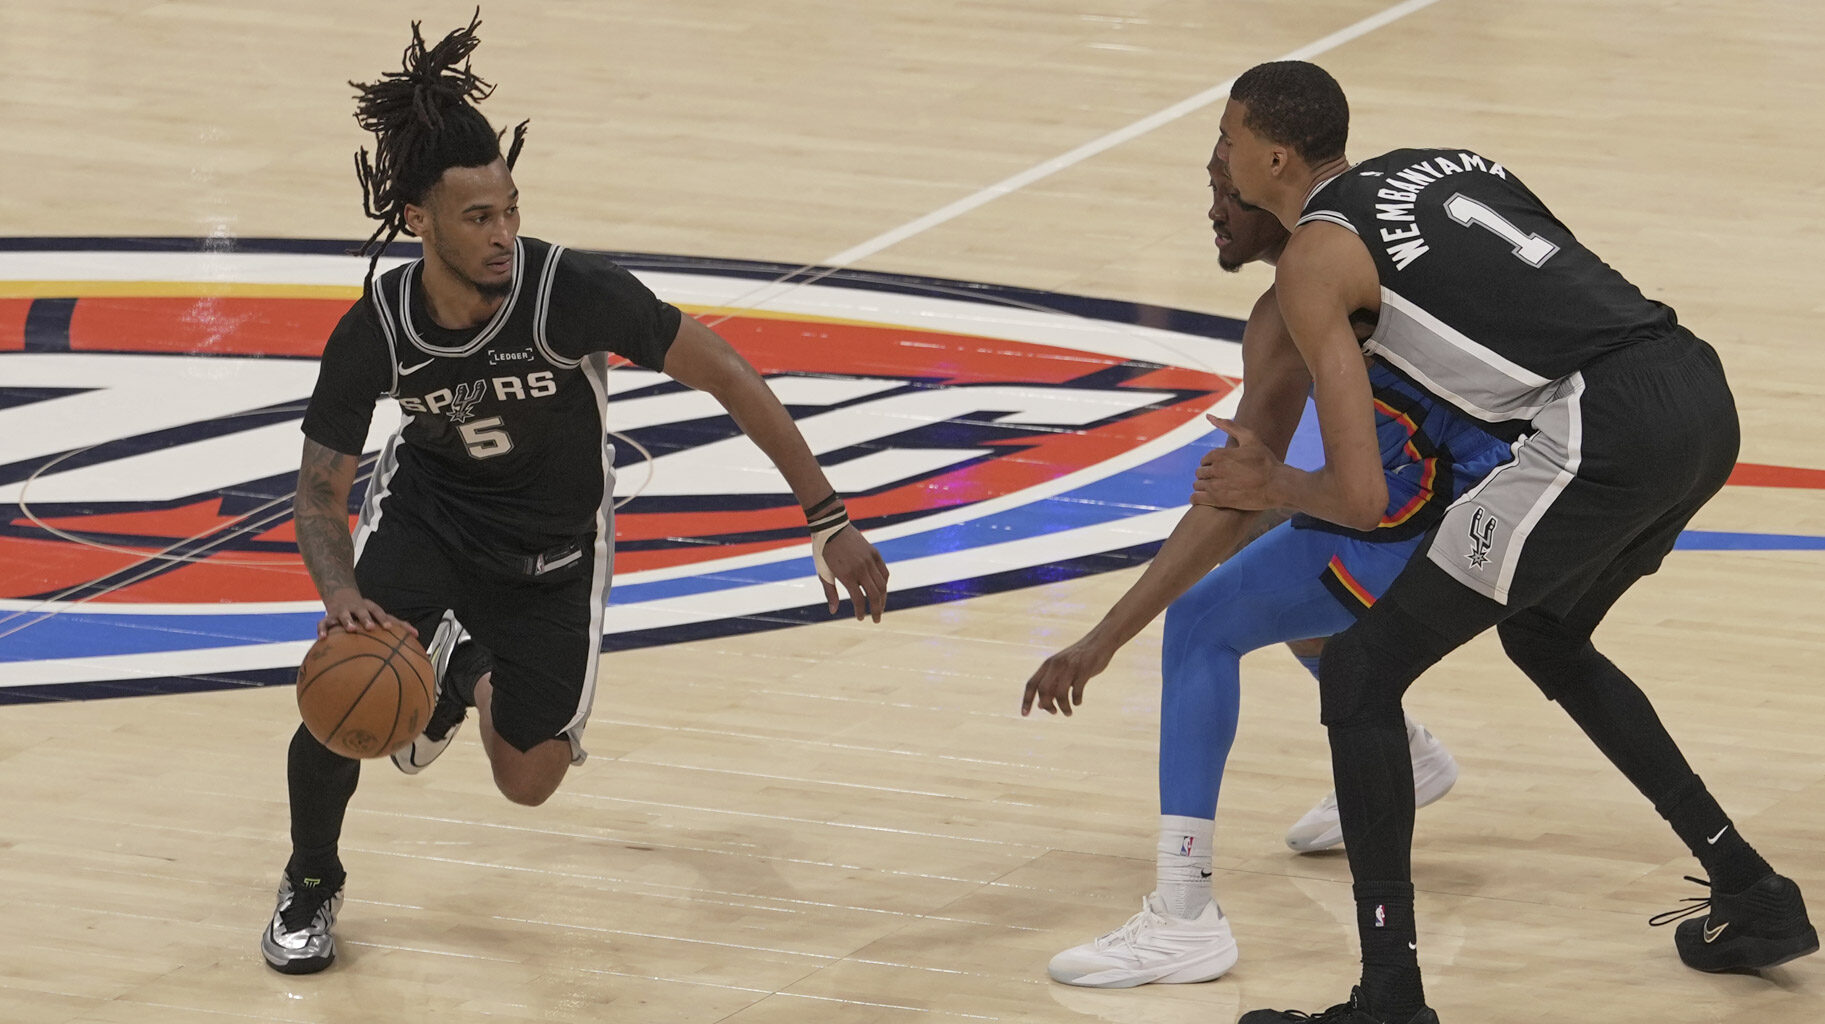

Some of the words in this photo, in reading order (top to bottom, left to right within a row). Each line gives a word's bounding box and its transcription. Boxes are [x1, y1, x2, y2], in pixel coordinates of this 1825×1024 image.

[1375, 153, 1506, 271] WEMBANYAMA
[1443, 192, 1560, 269] 1
[493, 351, 529, 362] LEDGER
[457, 416, 515, 460] 5
